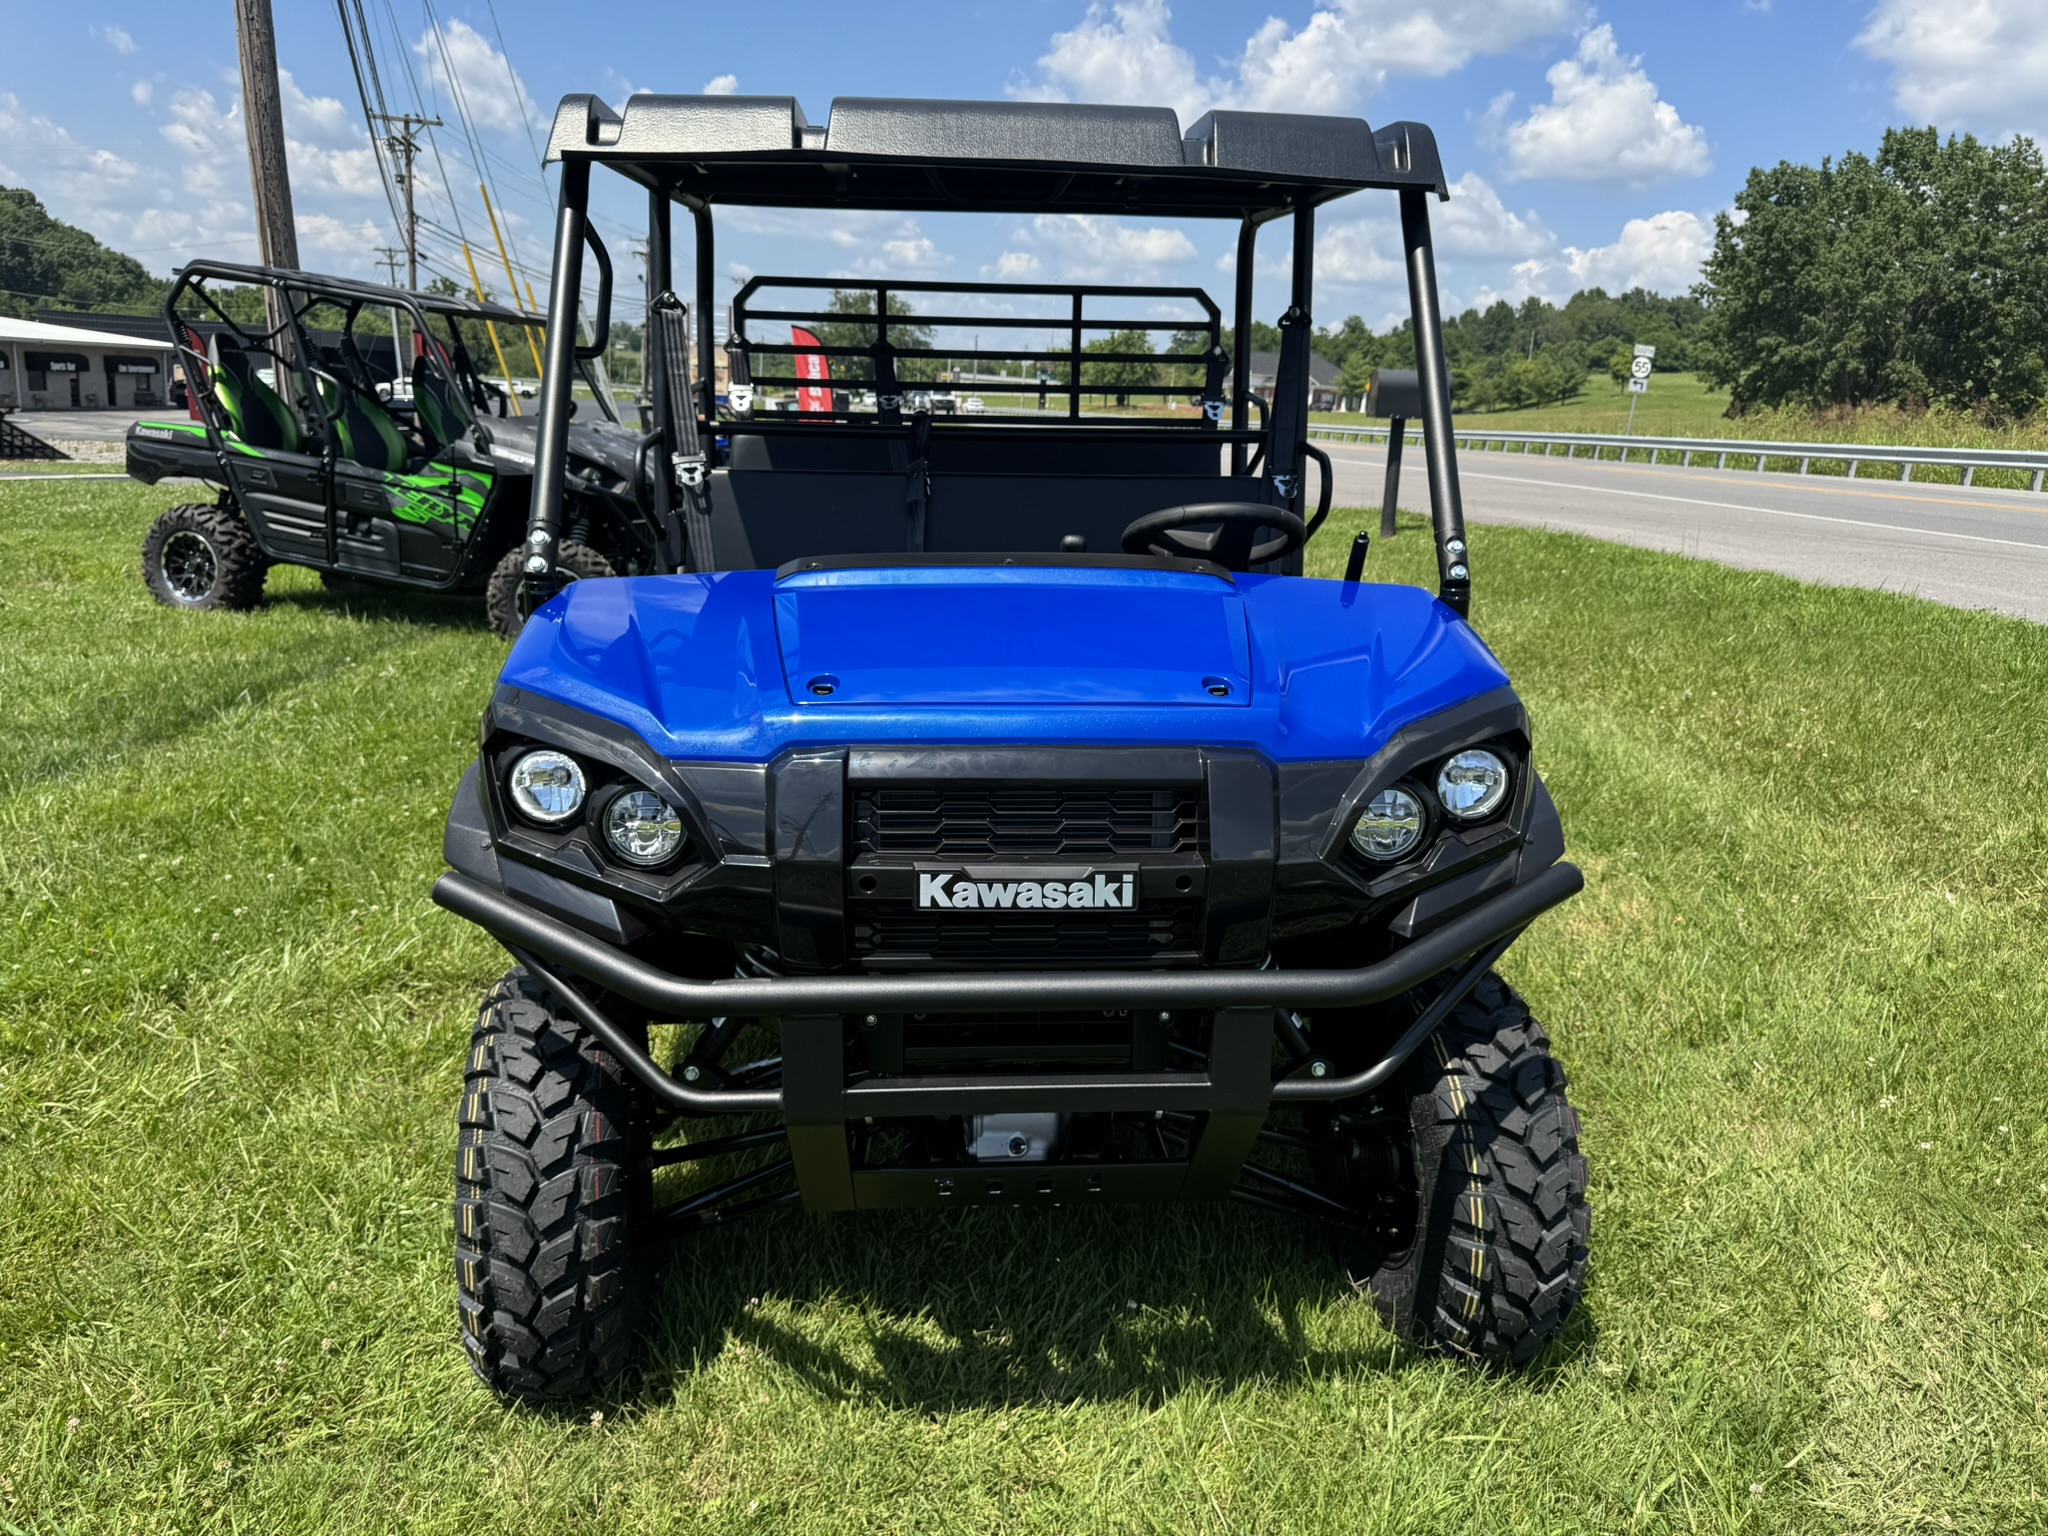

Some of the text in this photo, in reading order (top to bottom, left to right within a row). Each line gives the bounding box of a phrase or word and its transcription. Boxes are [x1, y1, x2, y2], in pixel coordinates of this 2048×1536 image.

[807, 351, 822, 398] Bbca
[1634, 361, 1649, 374] 55
[135, 426, 173, 440] Kawasaki
[919, 874, 1134, 908] Kawasaki
